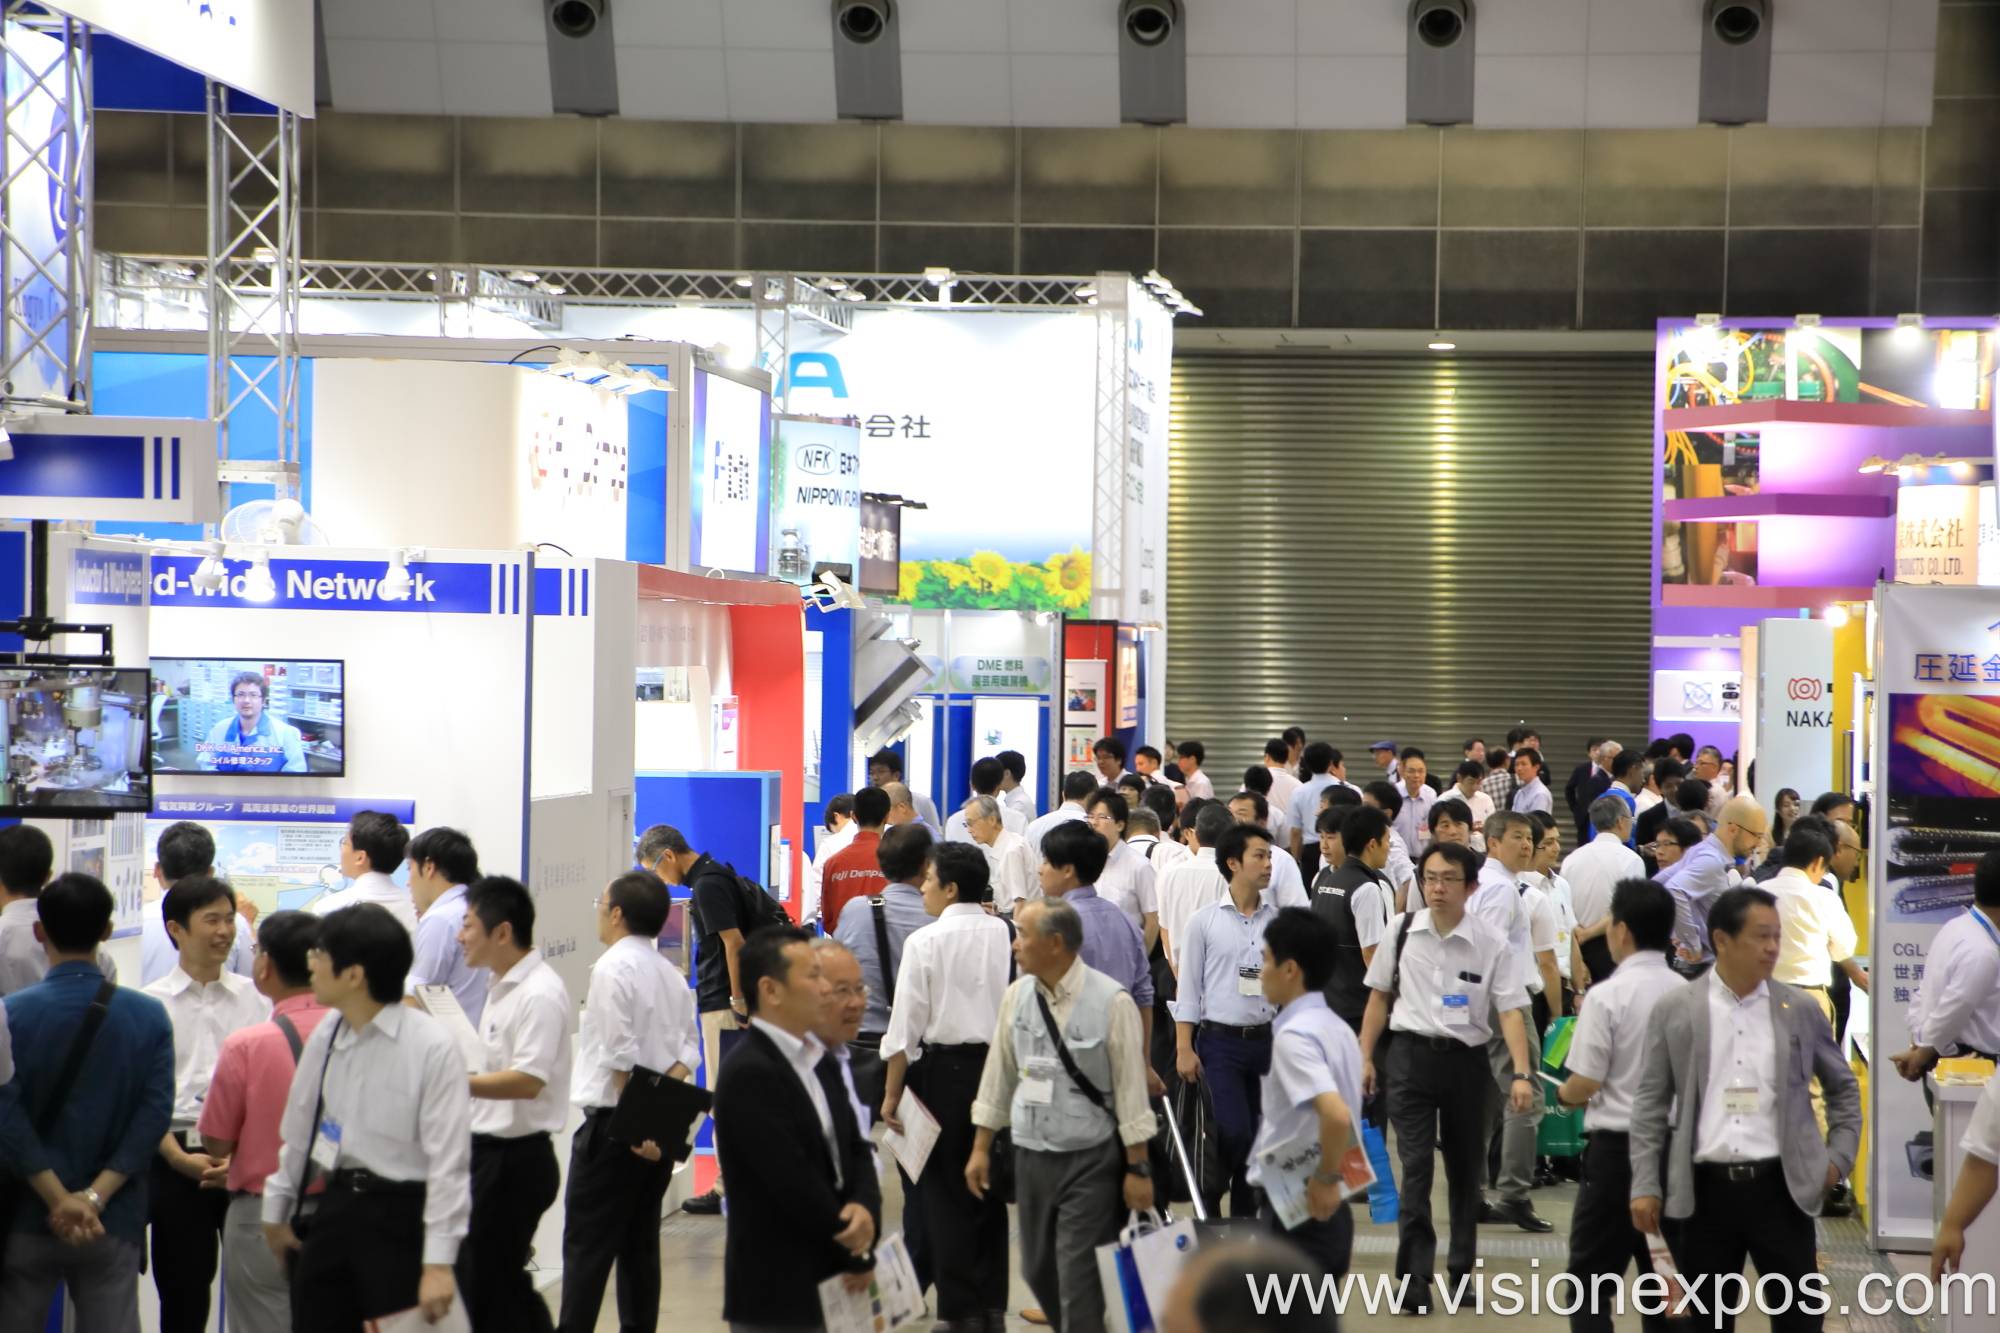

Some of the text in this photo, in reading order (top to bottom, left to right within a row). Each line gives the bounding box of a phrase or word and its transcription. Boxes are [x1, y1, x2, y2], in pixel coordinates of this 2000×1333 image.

[757, 352, 848, 398] A
[847, 414, 931, 438] 会社
[803, 450, 831, 469] NFK
[797, 486, 842, 505] NIPPON
[977, 659, 1002, 671] DME
[1722, 701, 1740, 713] Fu
[1893, 986, 1920, 1002] 独
